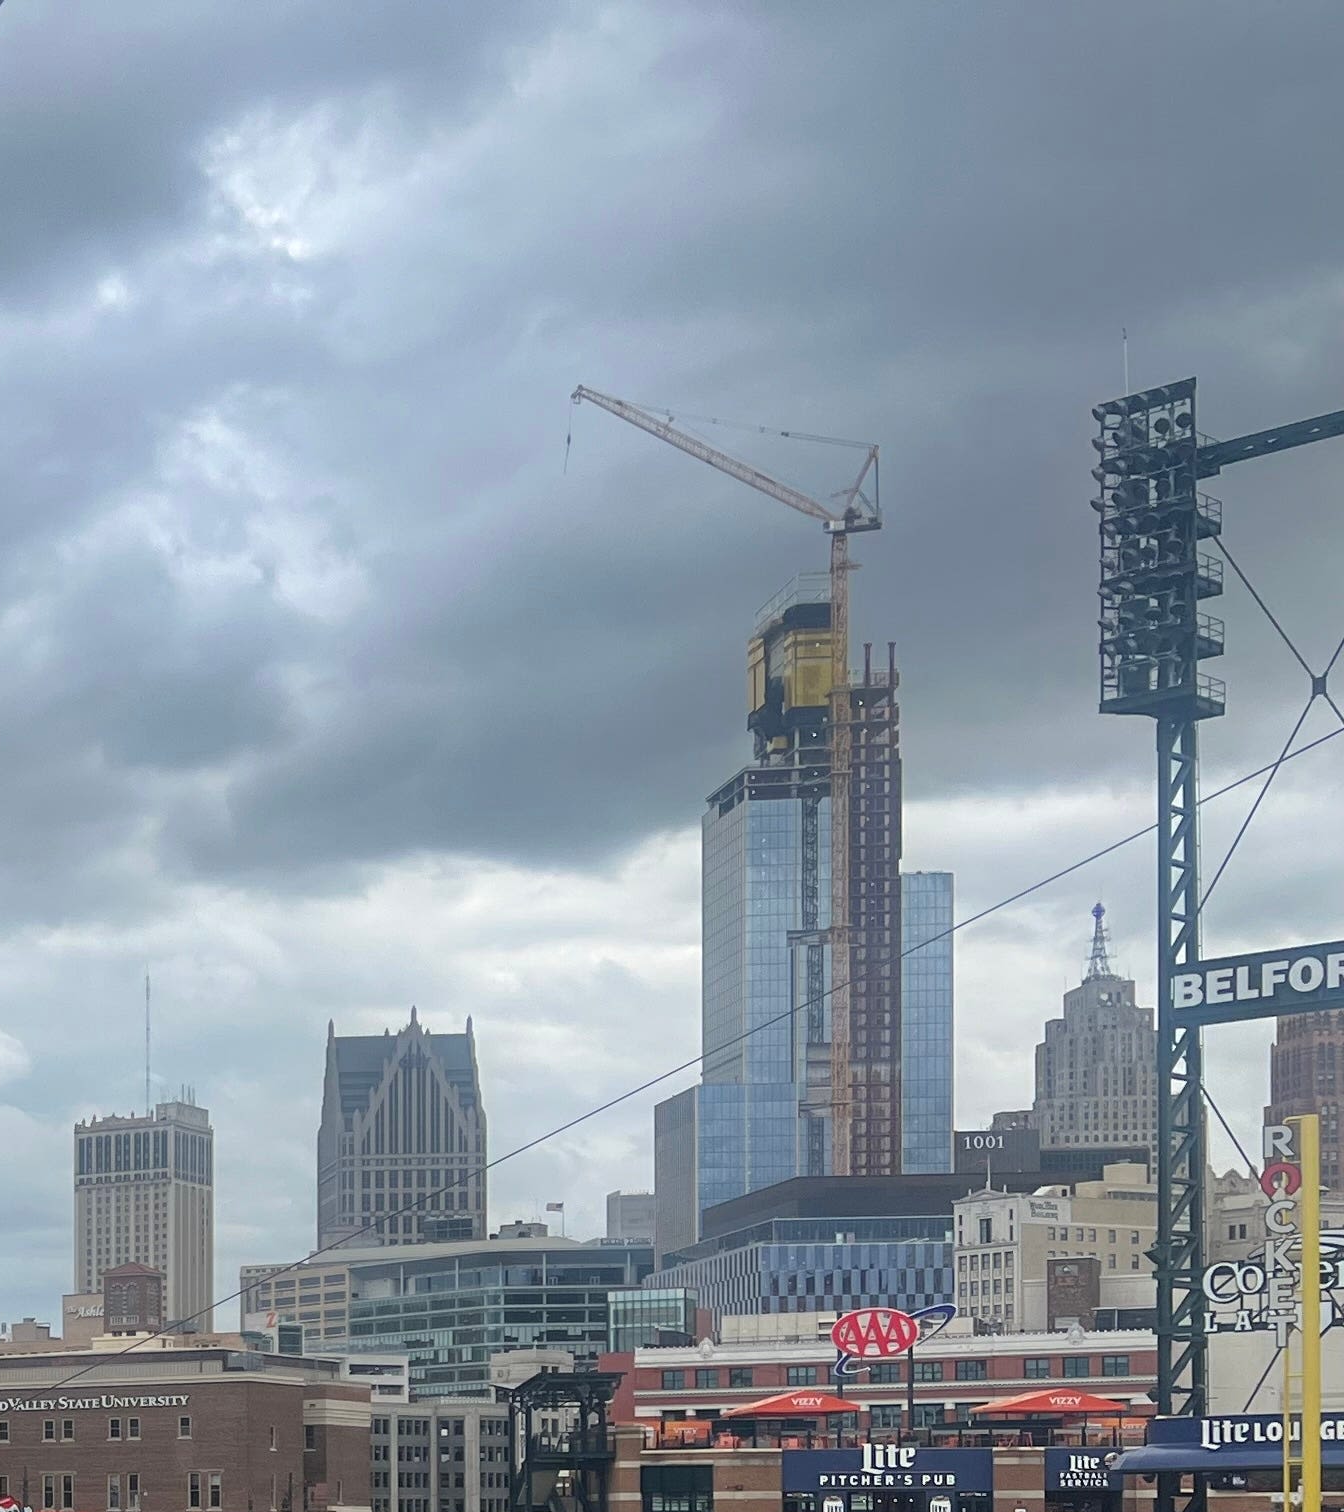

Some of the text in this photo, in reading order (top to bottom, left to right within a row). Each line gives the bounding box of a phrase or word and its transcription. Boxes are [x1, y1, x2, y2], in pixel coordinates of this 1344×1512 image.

[963, 1135, 1005, 1149] 1001
[838, 1308, 912, 1356] AAA
[791, 1397, 823, 1406] VIZZY
[1200, 1419, 1250, 1450] Lite
[860, 1442, 916, 1474] Lite
[1069, 1454, 1100, 1472] Lite
[819, 1473, 956, 1486] PITCHER'S PUB
[1059, 1479, 1109, 1487] SERVICE
